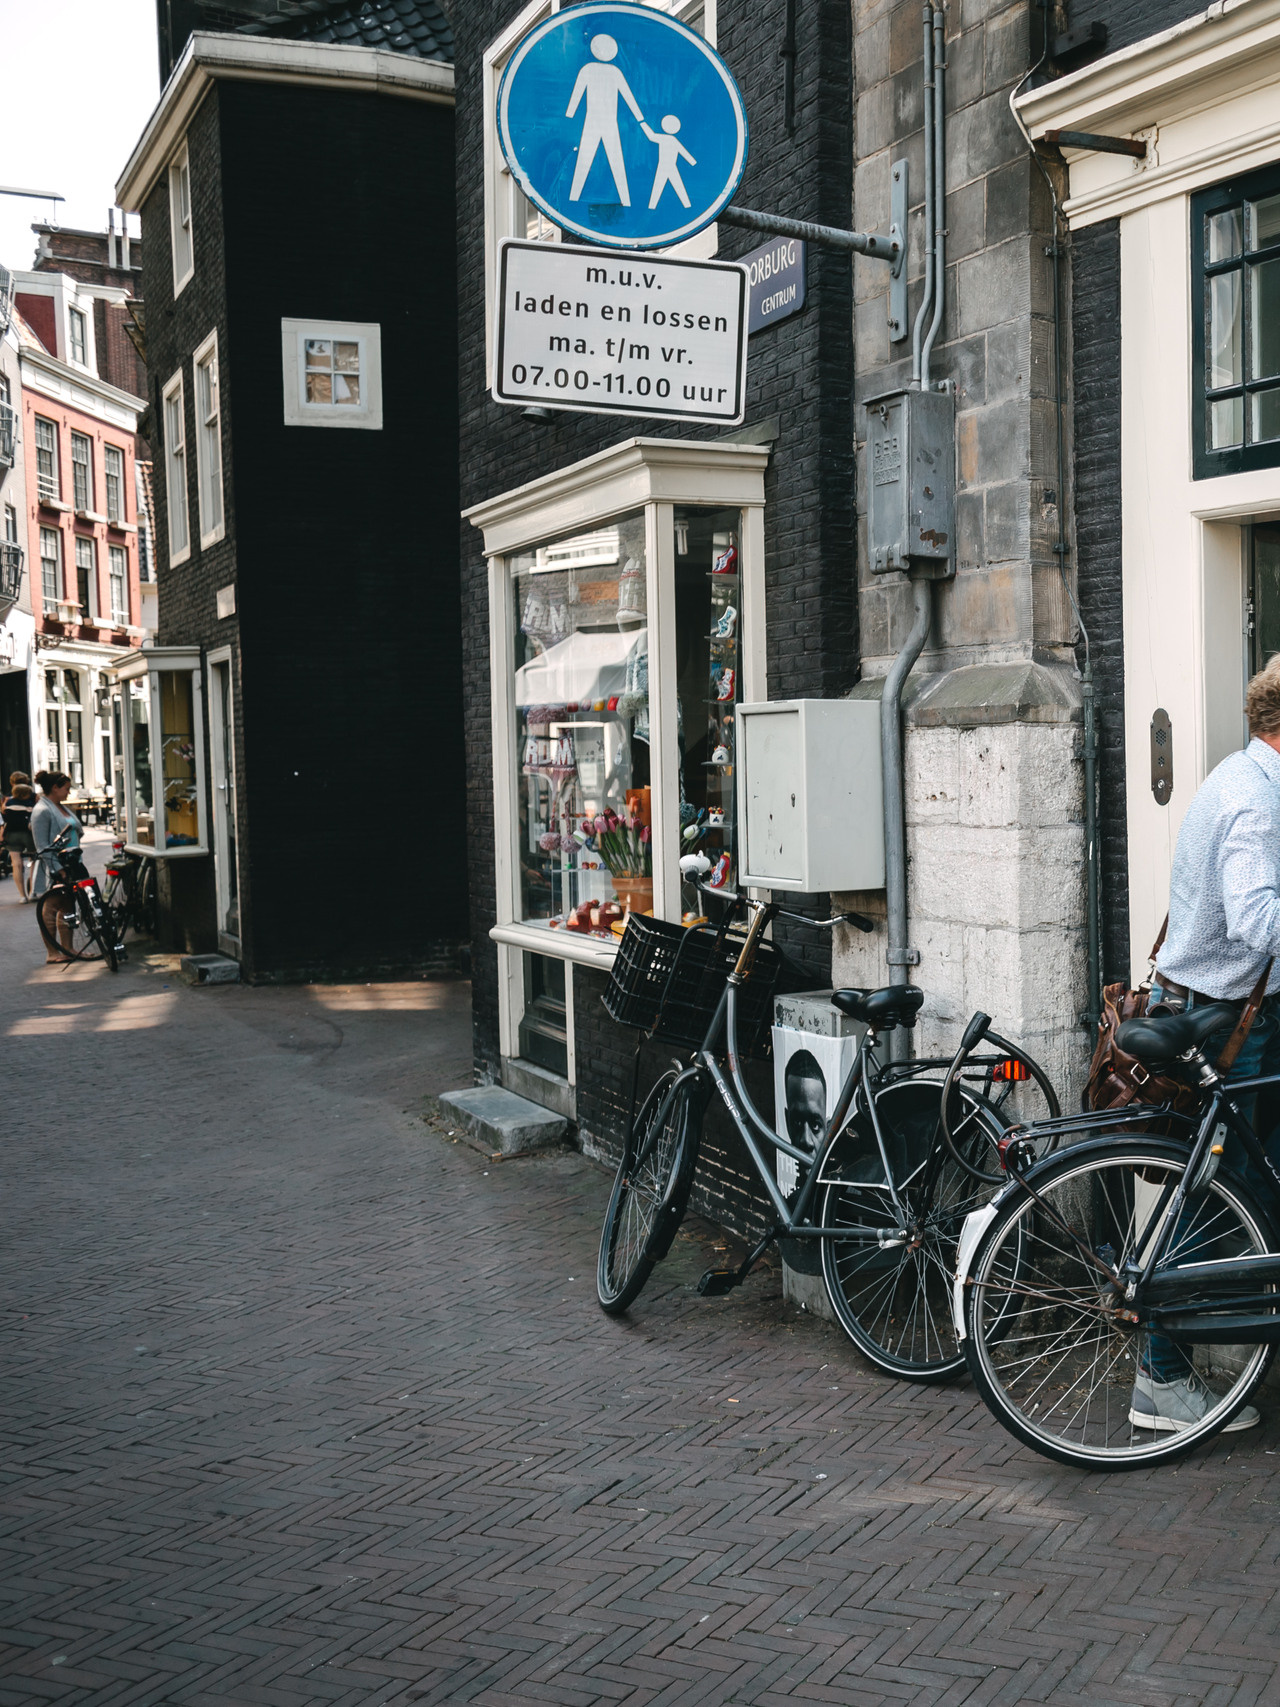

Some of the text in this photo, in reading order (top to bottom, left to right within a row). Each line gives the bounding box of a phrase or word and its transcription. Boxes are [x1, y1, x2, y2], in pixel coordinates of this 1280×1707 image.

[585, 266, 663, 290] m.u.v.
[749, 239, 796, 287] ORBURG
[514, 290, 728, 332] laden en lossen
[761, 283, 796, 316] CENTRUM
[549, 335, 694, 365] ma. t/m vr.
[511, 363, 728, 403] 07.00-11.00 uur
[778, 1153, 800, 1177] THE
